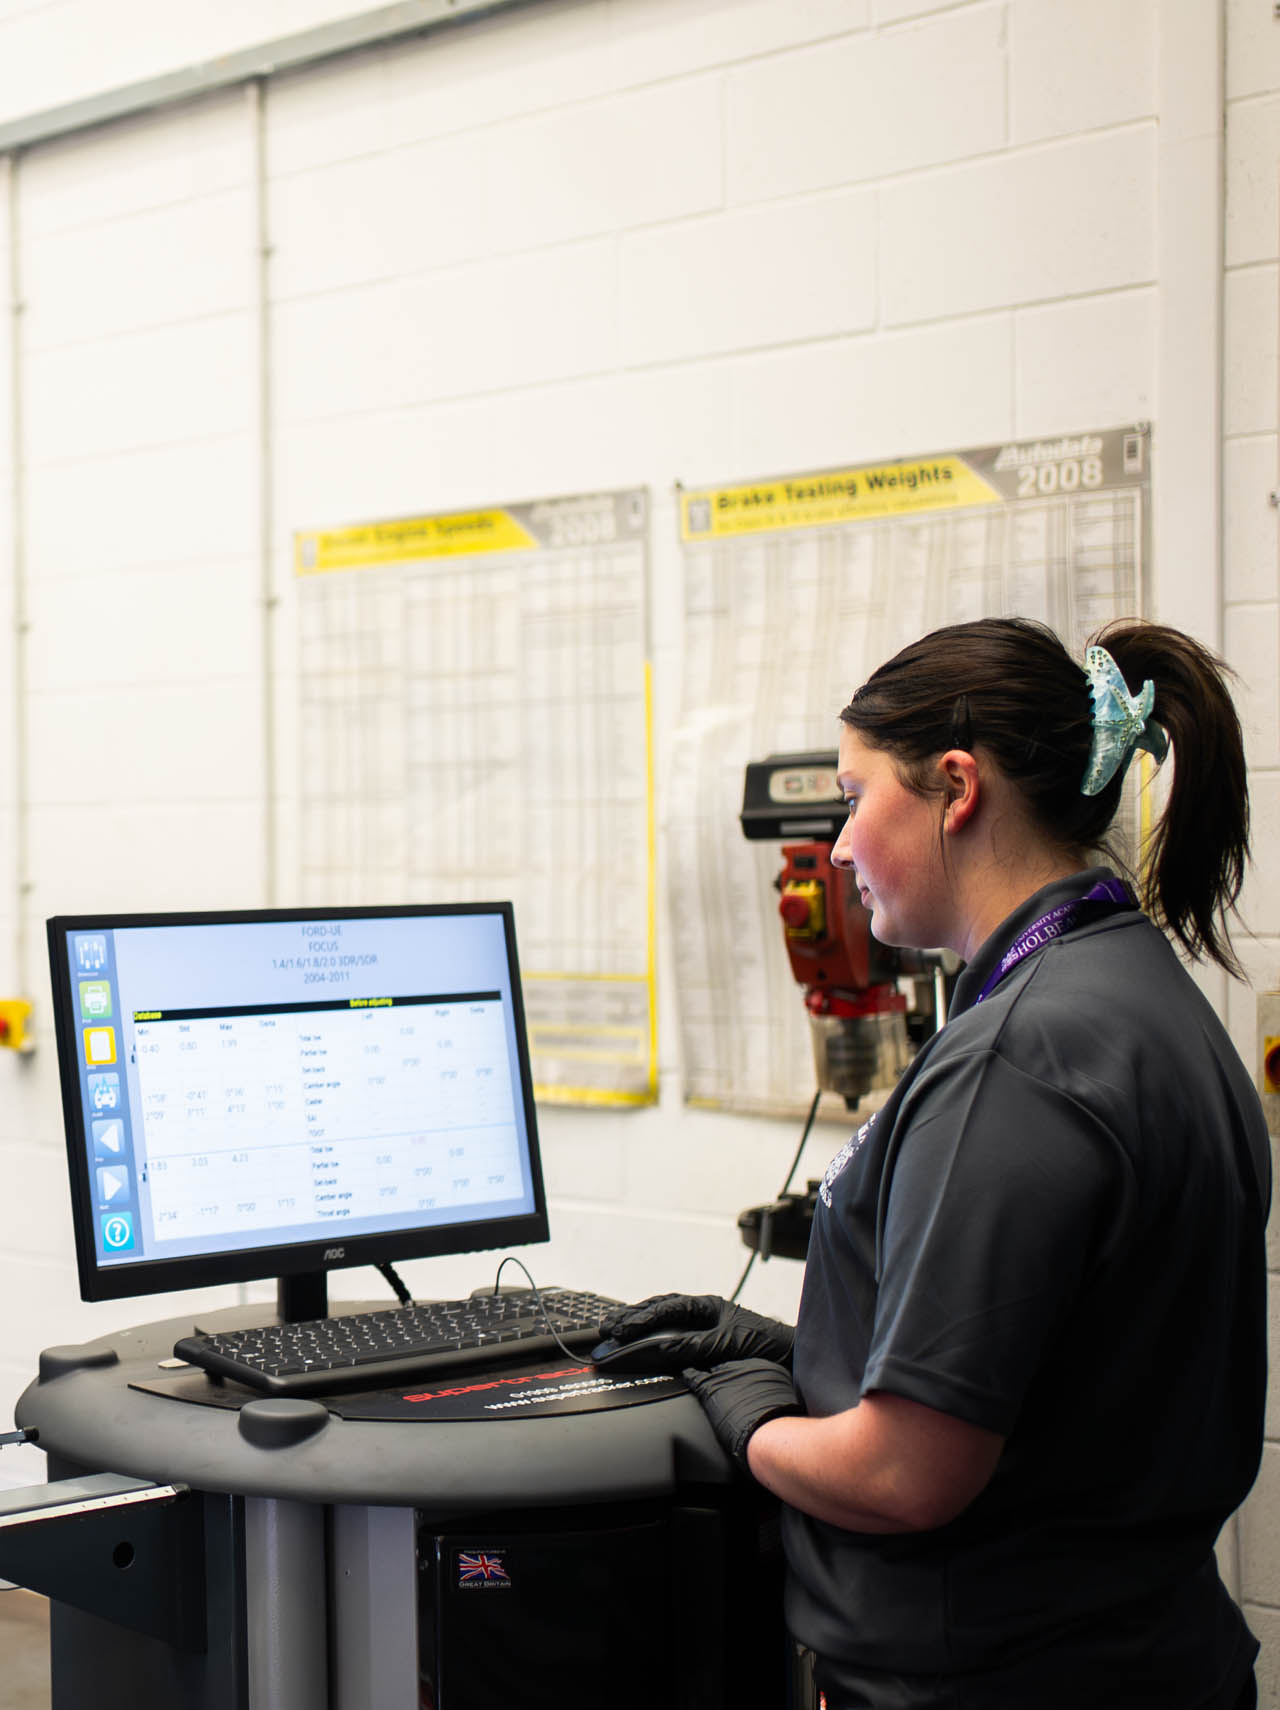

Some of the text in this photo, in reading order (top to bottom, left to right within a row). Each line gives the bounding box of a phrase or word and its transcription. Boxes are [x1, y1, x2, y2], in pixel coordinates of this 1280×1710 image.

[1019, 458, 1103, 497] 2008
[717, 464, 954, 510] Brake Testing Weights
[301, 925, 343, 937] FORD-UE
[308, 941, 339, 953] FOCUS
[304, 971, 350, 984] 2004-2011
[323, 1247, 345, 1261] AOC
